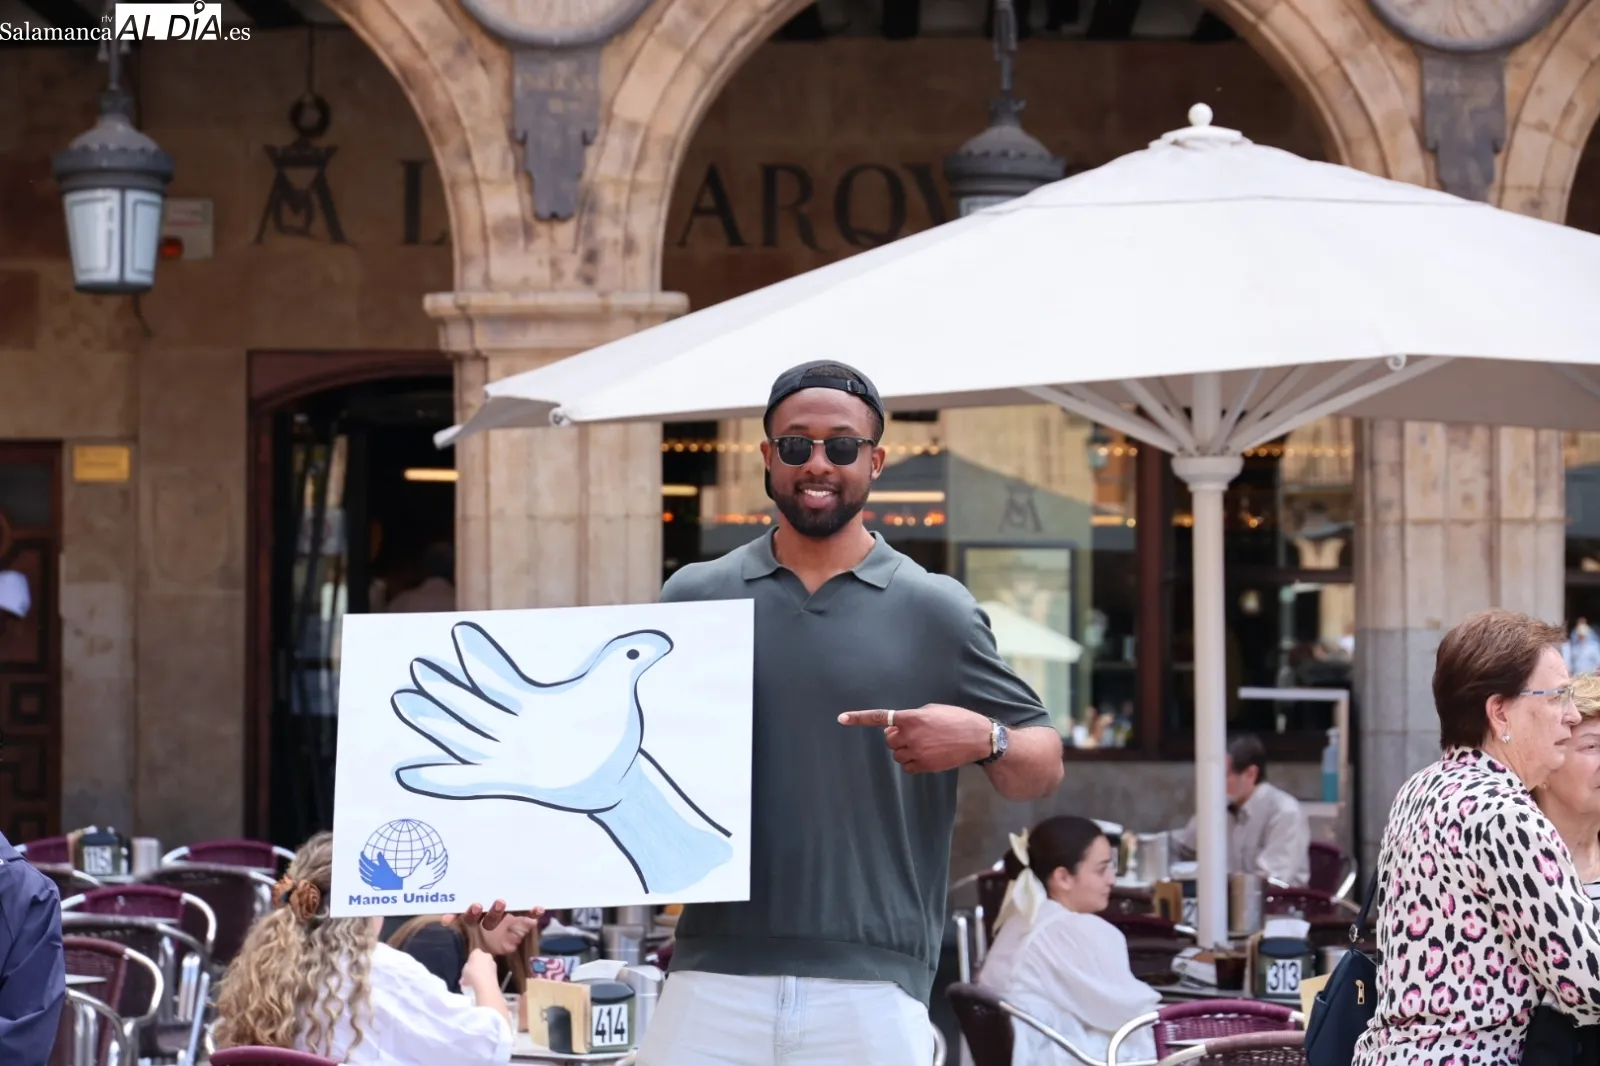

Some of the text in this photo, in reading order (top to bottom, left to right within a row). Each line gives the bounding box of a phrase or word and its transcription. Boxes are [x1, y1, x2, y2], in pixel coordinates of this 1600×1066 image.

[349, 892, 455, 905] Manos Unidas
[1268, 962, 1299, 991] 313
[595, 1006, 626, 1043] 414
